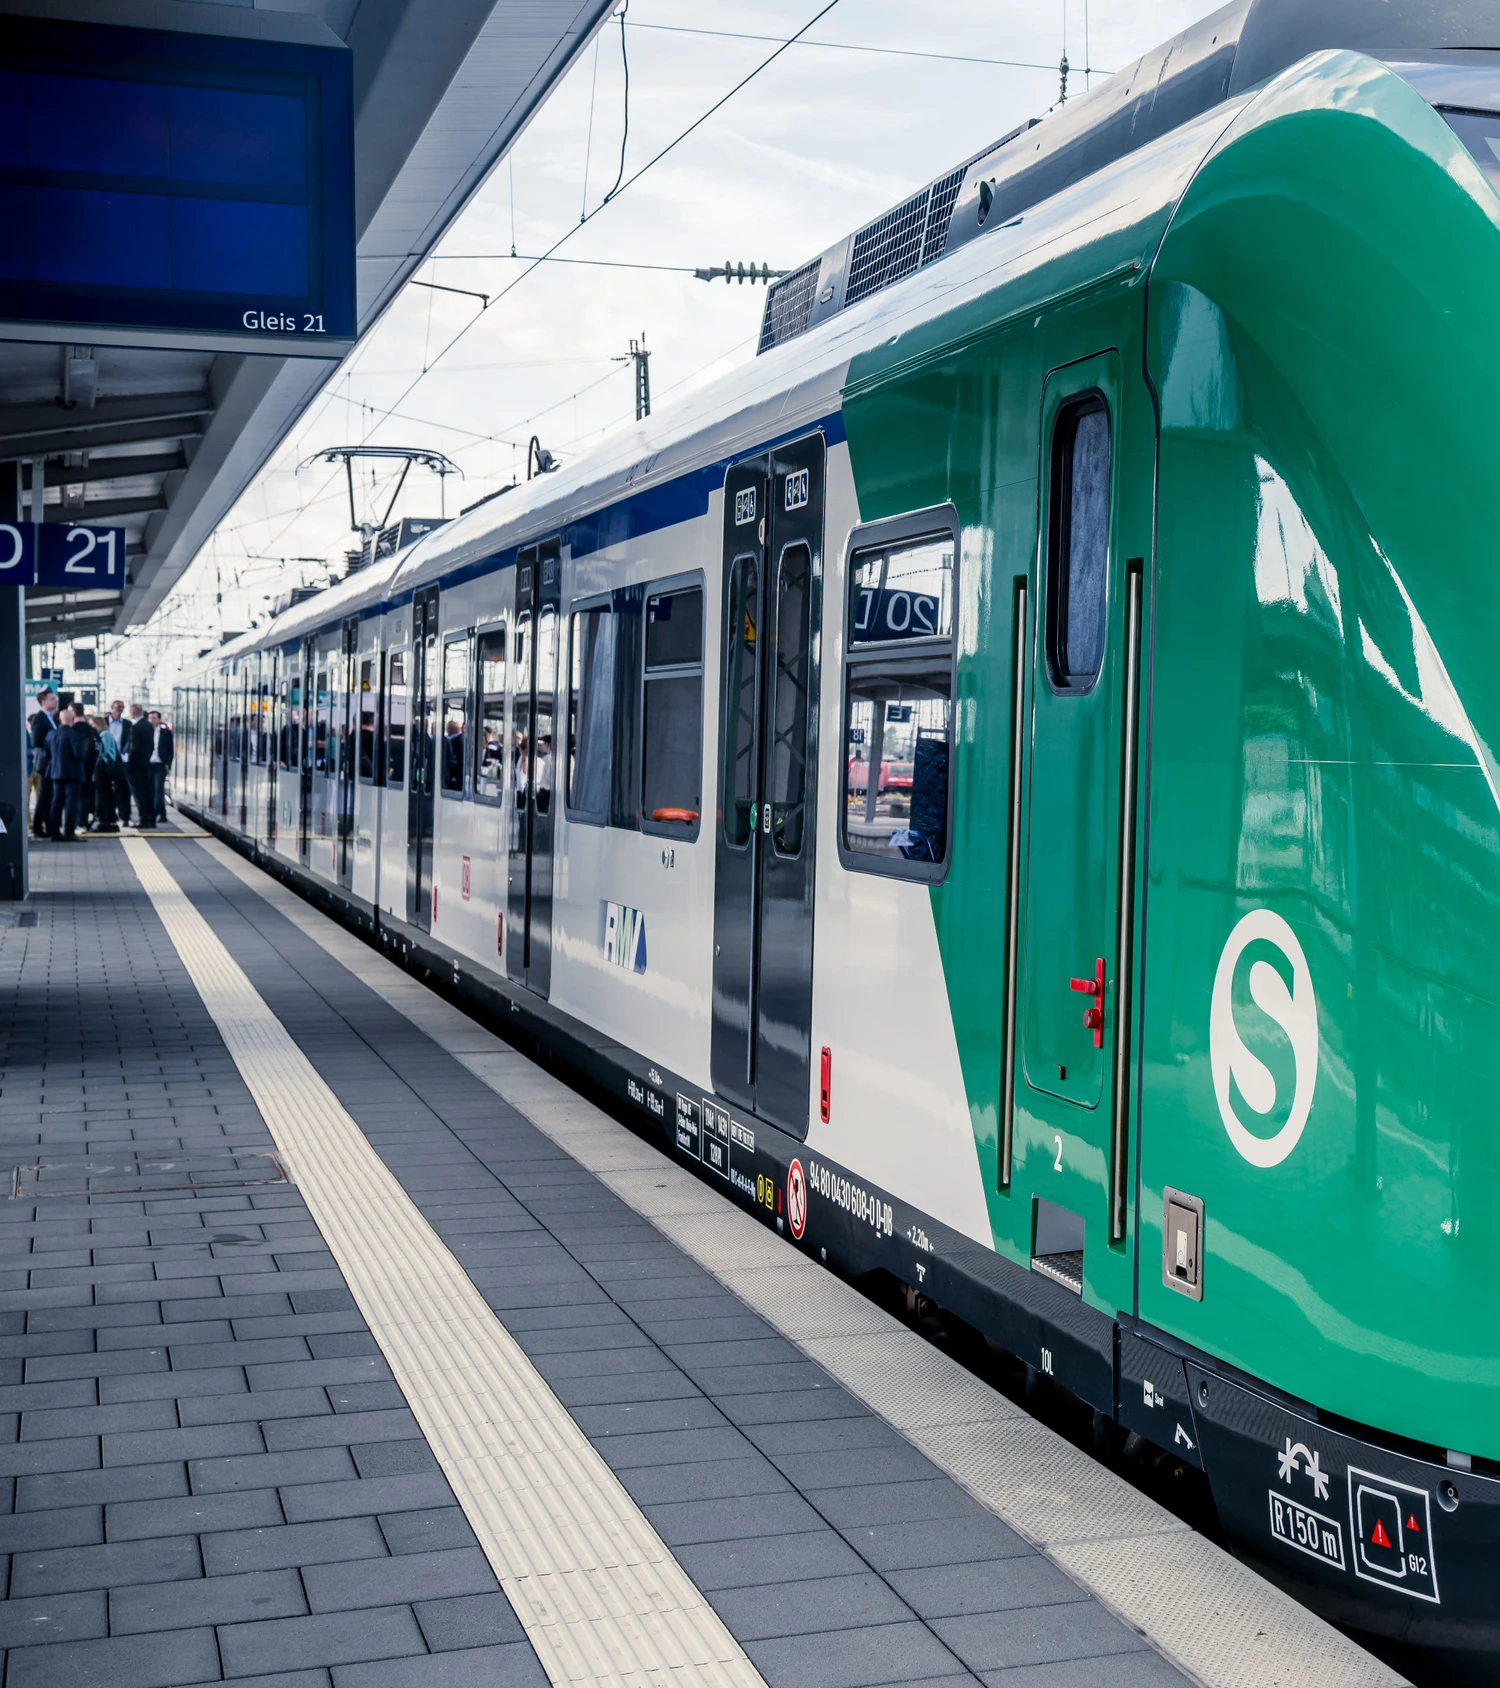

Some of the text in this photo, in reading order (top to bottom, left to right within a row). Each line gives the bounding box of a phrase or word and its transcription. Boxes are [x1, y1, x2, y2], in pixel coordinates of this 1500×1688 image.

[242, 310, 326, 333] Gleis 21
[64, 527, 116, 575] 21
[603, 900, 643, 972] RMV
[1053, 1134, 1064, 1172] 2
[810, 1160, 893, 1238] 94 80 0430 608-0 D-DB
[1041, 1347, 1054, 1376] 10L
